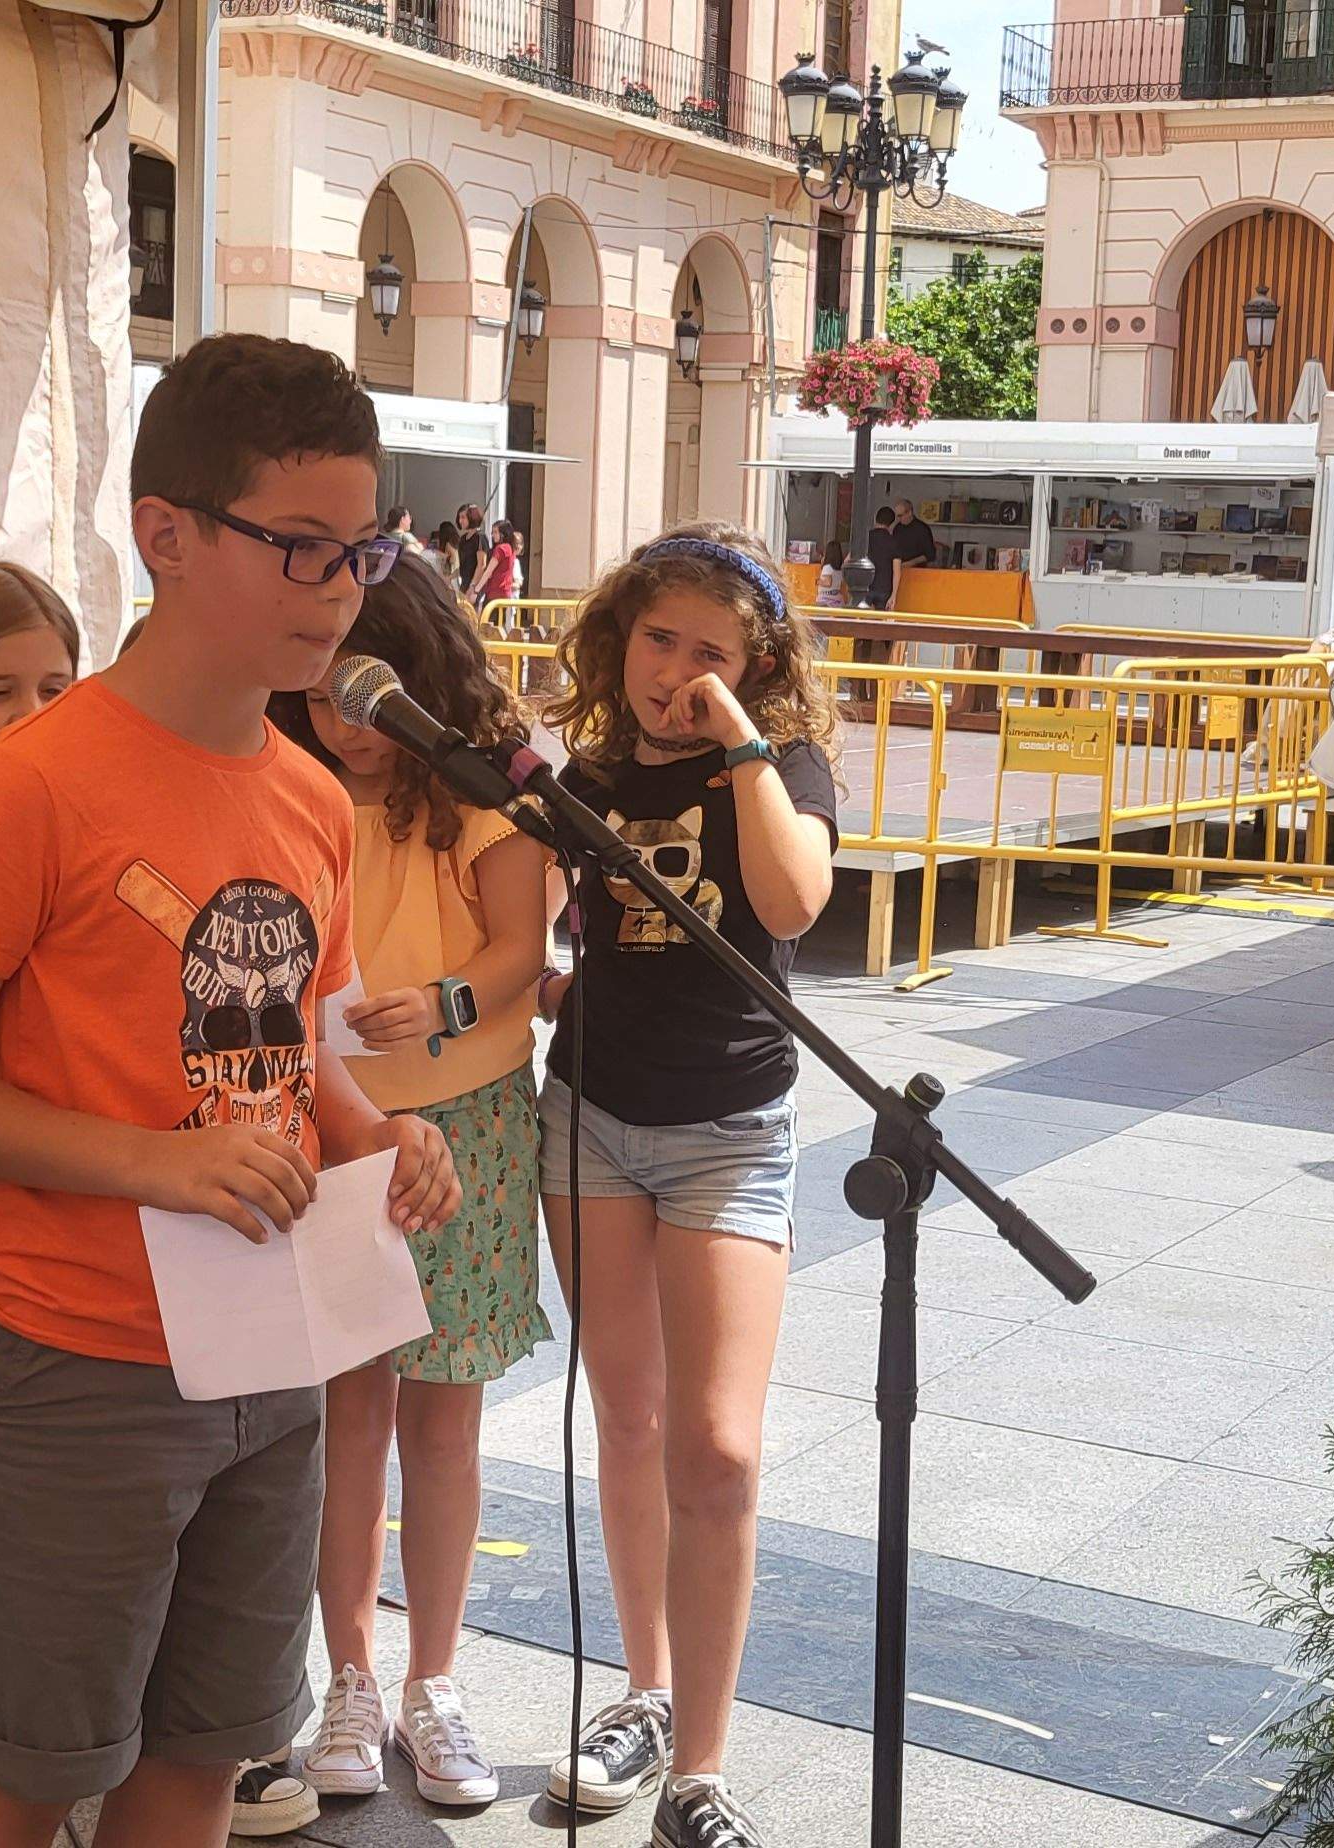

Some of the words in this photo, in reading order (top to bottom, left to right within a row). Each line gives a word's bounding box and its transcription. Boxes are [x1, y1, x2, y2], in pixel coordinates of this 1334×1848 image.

[873, 442, 907, 452] Editorial
[908, 443, 953, 453] Cosquillas
[1184, 448, 1211, 459] editor
[248, 885, 287, 905] GOODS
[195, 908, 244, 958] NEW
[244, 908, 308, 960] YORK
[182, 951, 232, 1007] YOUTH
[182, 1047, 255, 1090] STAY
[231, 1099, 257, 1124] CITY
